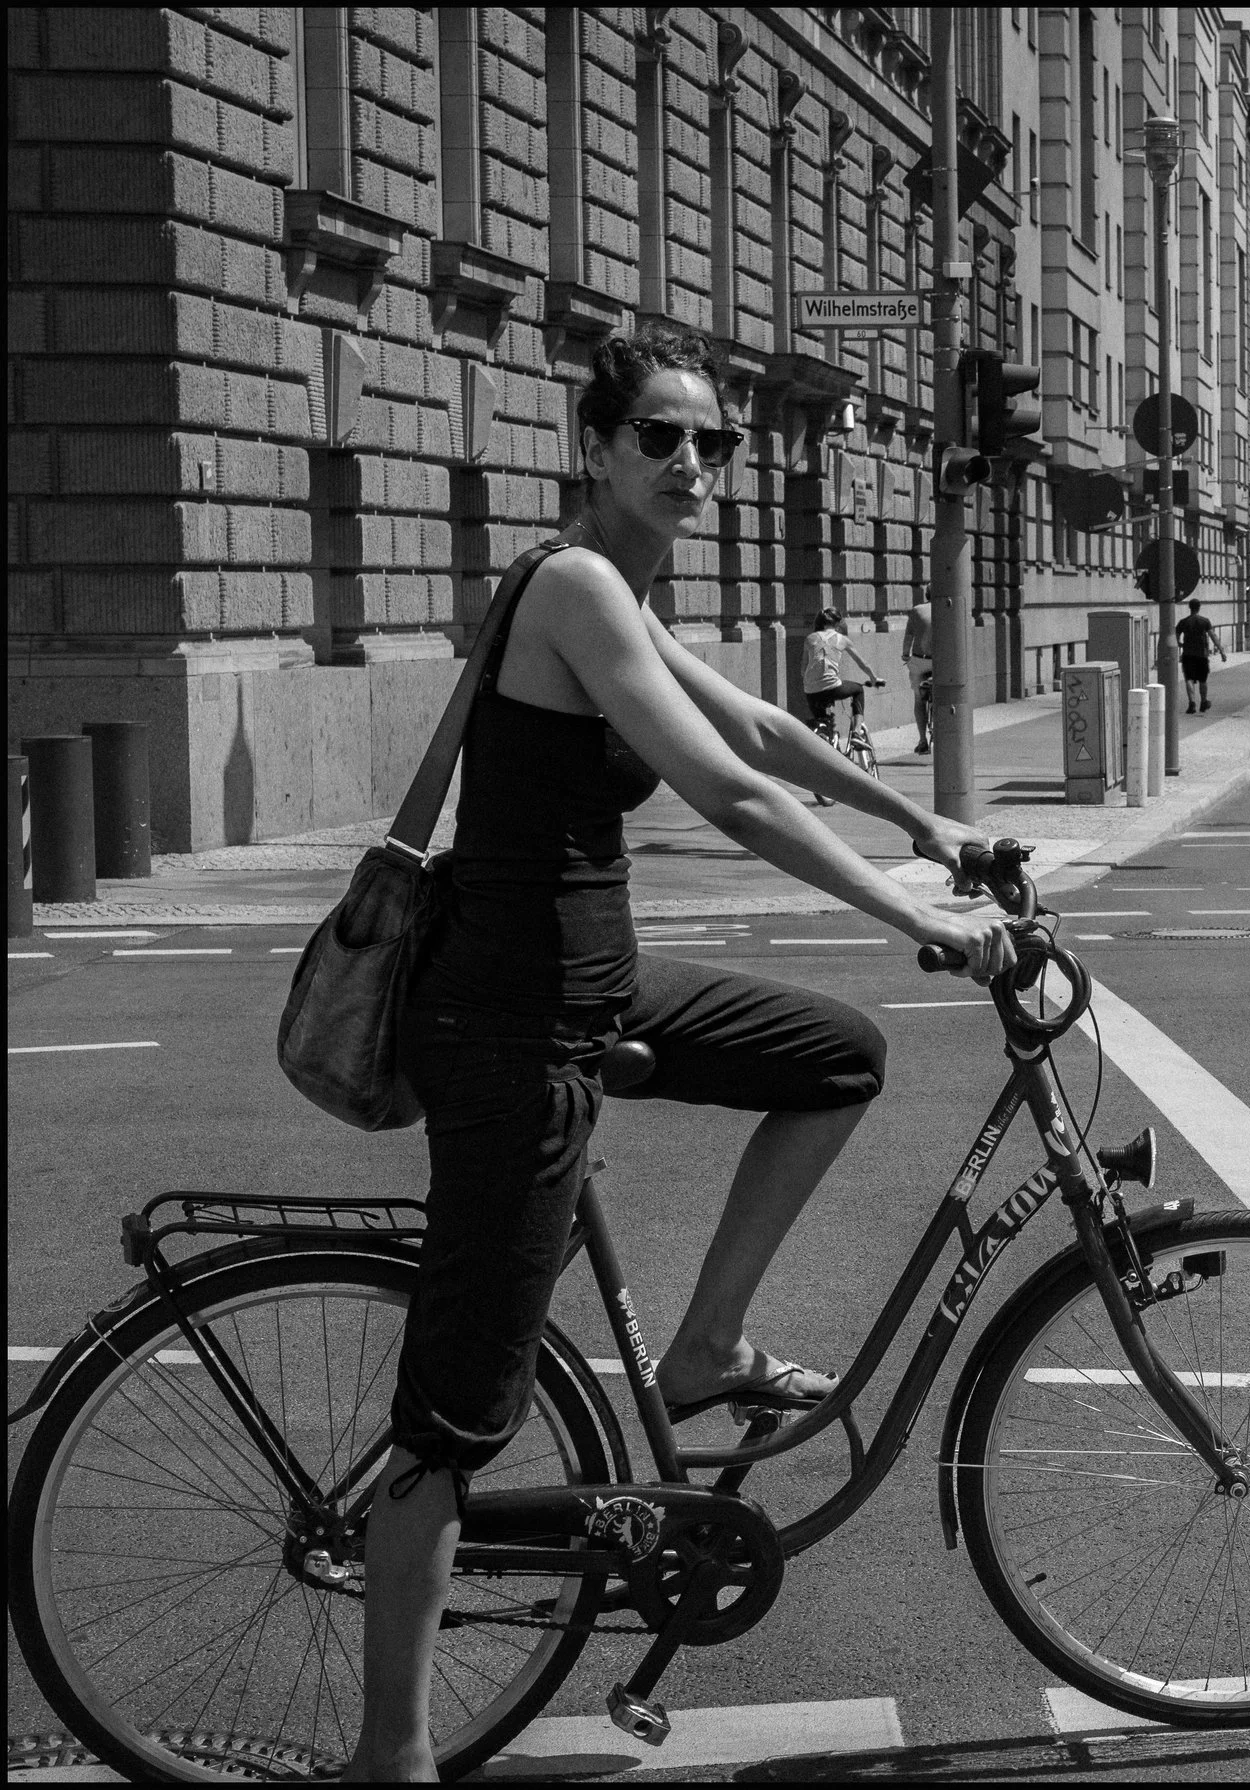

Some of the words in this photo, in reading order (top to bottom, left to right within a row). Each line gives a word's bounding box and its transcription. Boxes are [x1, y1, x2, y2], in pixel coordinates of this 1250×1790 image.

[805, 299, 917, 320] Wilhelmstraße
[955, 1124, 1002, 1197] BERLIN
[625, 1318, 657, 1389] BERLIN
[595, 1501, 651, 1529] BERLIN
